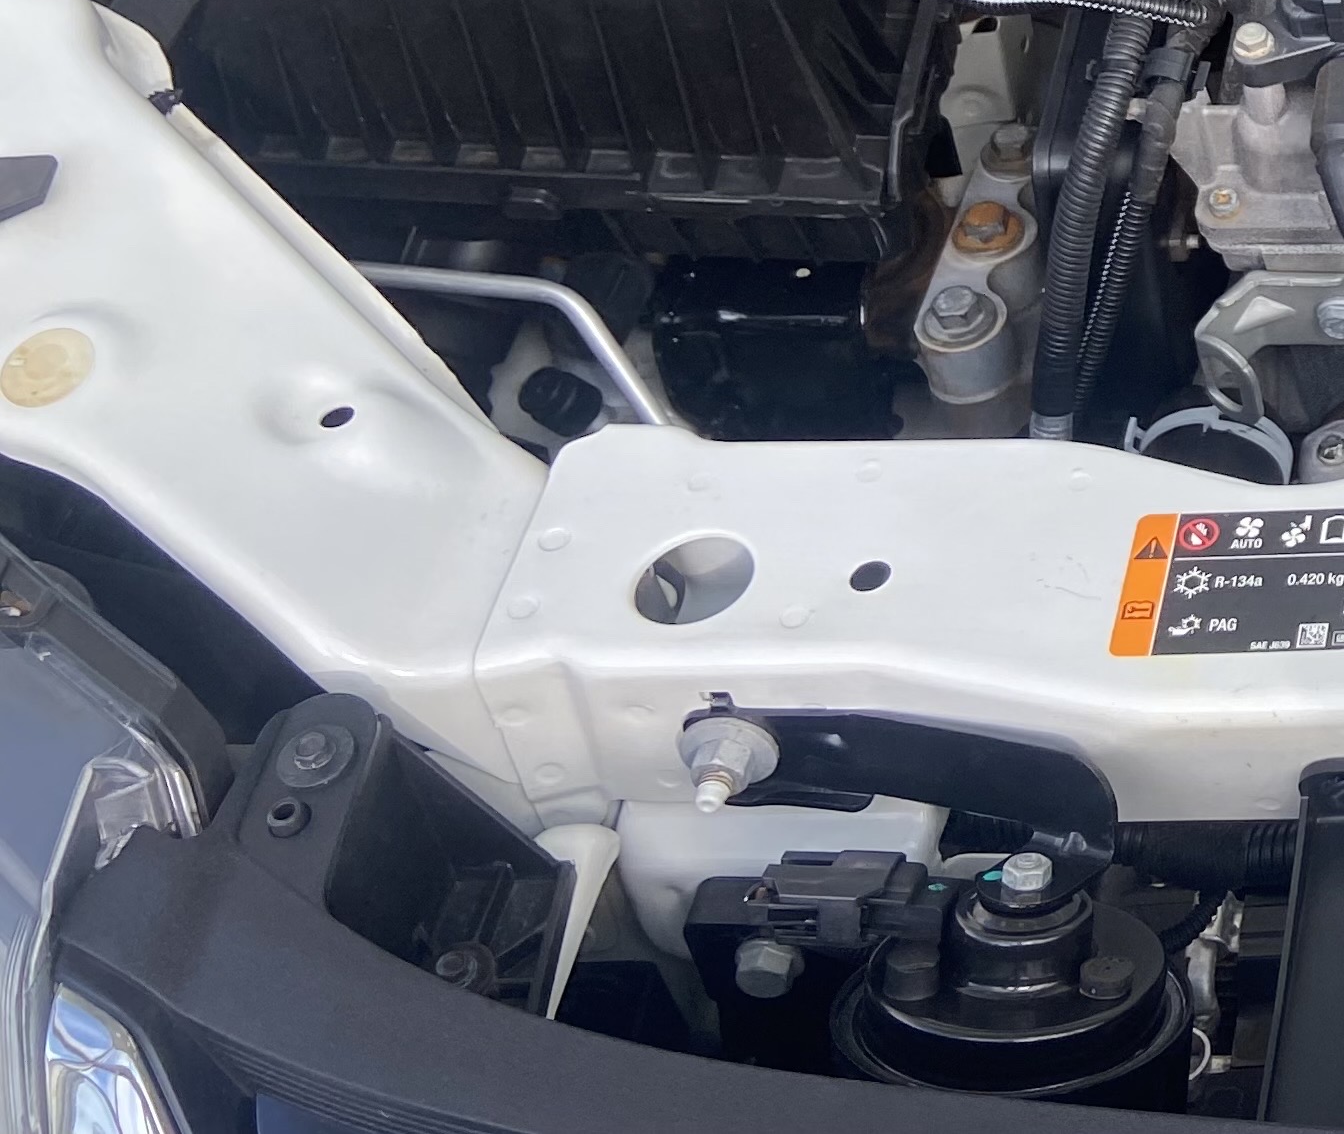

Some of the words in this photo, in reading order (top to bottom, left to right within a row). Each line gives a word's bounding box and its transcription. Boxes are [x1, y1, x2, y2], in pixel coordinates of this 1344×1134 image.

[1230, 538, 1263, 549] AUTO
[1214, 575, 1264, 588] R-134a
[1287, 573, 1326, 585] 0.420
[1327, 572, 1344, 586] kg
[1208, 618, 1238, 632] PAG
[1250, 640, 1269, 650] SAE
